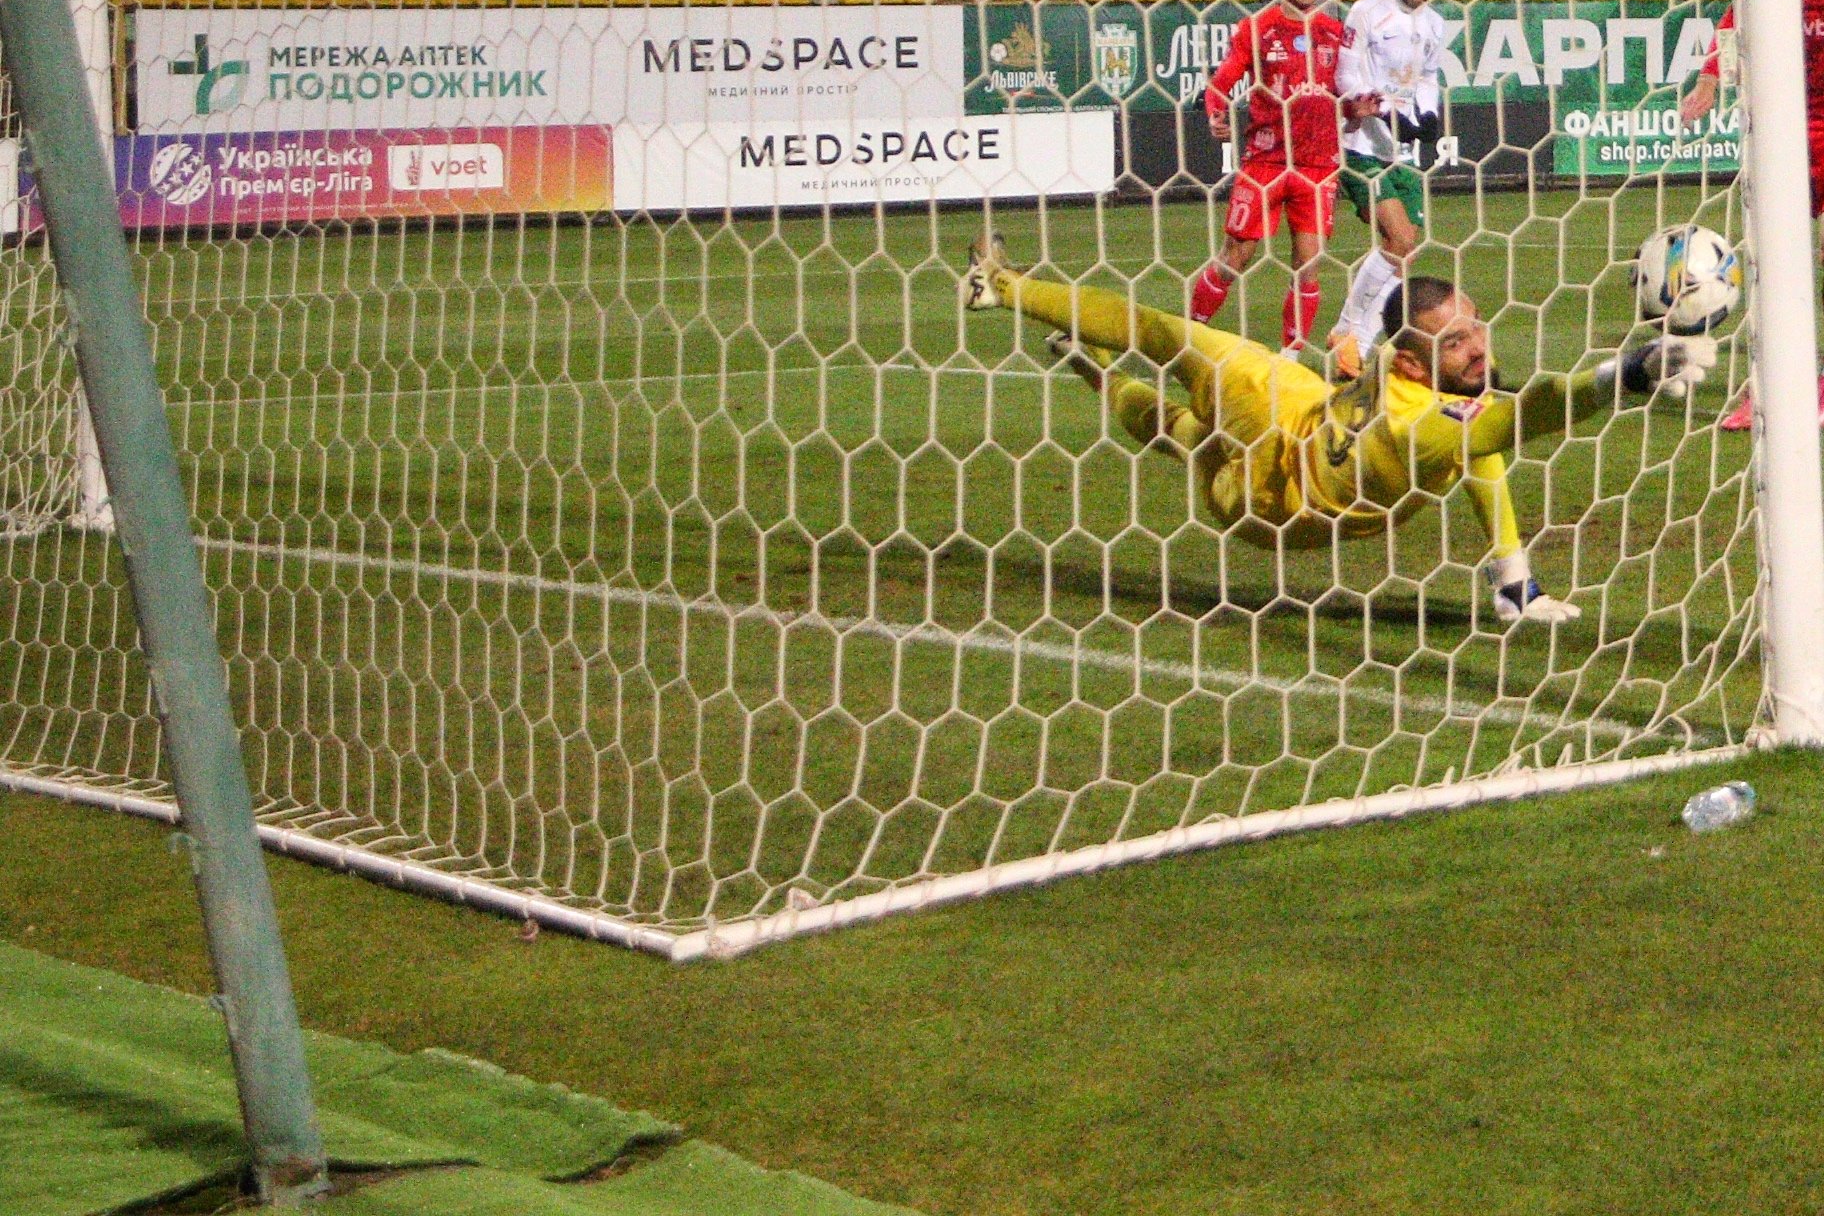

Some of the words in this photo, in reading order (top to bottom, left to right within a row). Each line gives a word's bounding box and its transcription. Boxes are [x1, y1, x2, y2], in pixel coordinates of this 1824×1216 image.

[269, 45, 390, 67] МЕРЕЖА
[399, 44, 488, 66] АПТЕК
[643, 34, 920, 73] MEDSPACE
[269, 69, 548, 105] ПОДОРОЖНИК
[217, 142, 373, 174] Українська
[740, 128, 1000, 168] MEDSPACE
[430, 155, 488, 176] vbet
